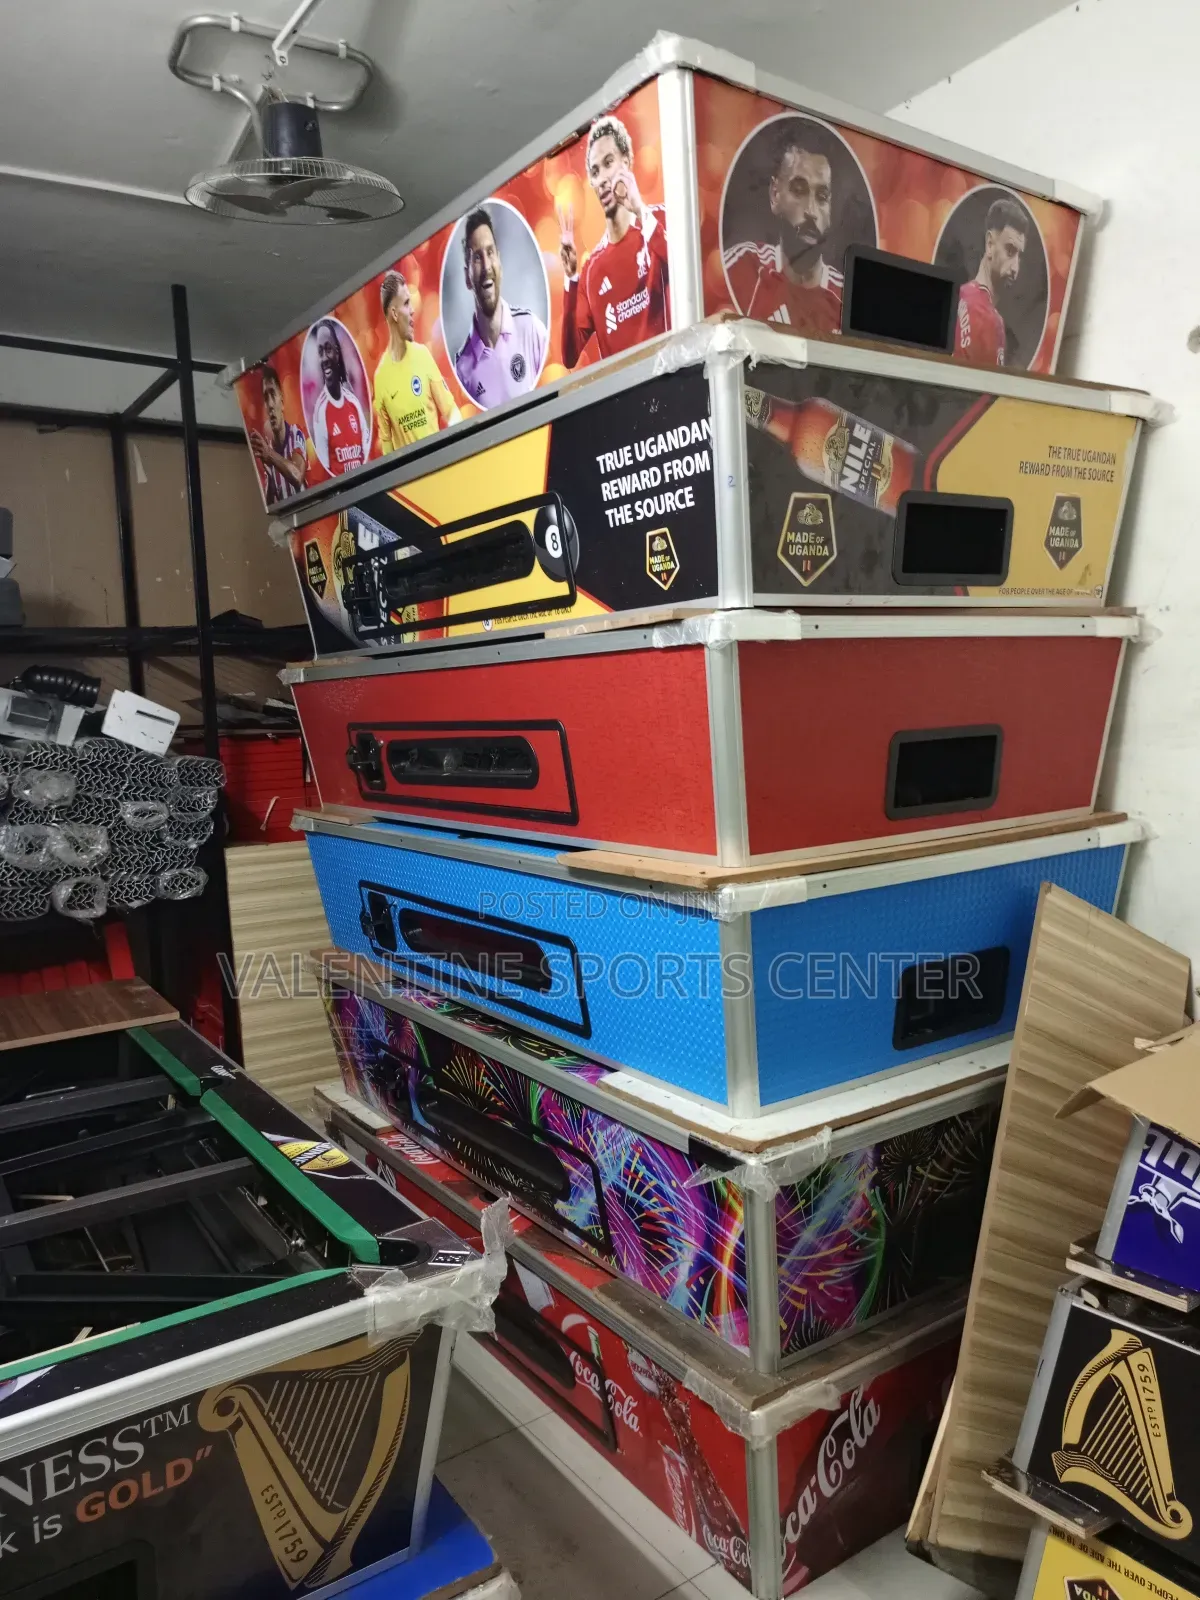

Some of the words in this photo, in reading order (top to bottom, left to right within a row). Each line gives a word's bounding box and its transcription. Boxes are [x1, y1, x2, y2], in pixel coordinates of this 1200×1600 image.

[616, 287, 650, 313] standard
[618, 297, 650, 323] chartered
[398, 408, 426, 425] AMERICAN
[403, 418, 428, 433] EXPRESS
[596, 446, 634, 474] TRUE
[634, 416, 714, 461] UGANDAN
[839, 423, 873, 494] NILE
[1048, 445, 1062, 460] THE
[1063, 447, 1081, 462] TRUE
[1082, 449, 1116, 466] UGANDAN
[601, 467, 662, 501] REWARD
[663, 450, 711, 483] FROM
[858, 441, 877, 491] SPECIAL
[1019, 461, 1050, 477] REWARD
[1051, 464, 1073, 479] FROM
[1074, 466, 1087, 480] THE
[1088, 468, 1115, 483] SOURCE
[605, 504, 634, 528] THE
[635, 486, 695, 521] SOURCE
[551, 532, 559, 551] 8
[787, 532, 815, 544] MADE
[816, 536, 825, 544] OF
[1049, 526, 1070, 537] MADE
[788, 544, 829, 557] UGANDA
[1049, 537, 1079, 549] UGANDA
[650, 555, 665, 565] MADE
[652, 561, 675, 573] UGANDA
[1010, 587, 1030, 595] PEOPLE
[1031, 587, 1045, 595] OVER
[1045, 587, 1055, 595] THE
[1056, 587, 1066, 595] AGE
[1137, 1363, 1156, 1402] 1759
[782, 1384, 880, 1564] ca-Cola
[32, 1513, 63, 1545] is
[274, 1519, 309, 1563] 1759
[1077, 1541, 1089, 1554] OF
[1089, 1548, 1105, 1563] AGE
[1106, 1558, 1122, 1574] THE
[1123, 1567, 1146, 1587] OVER
